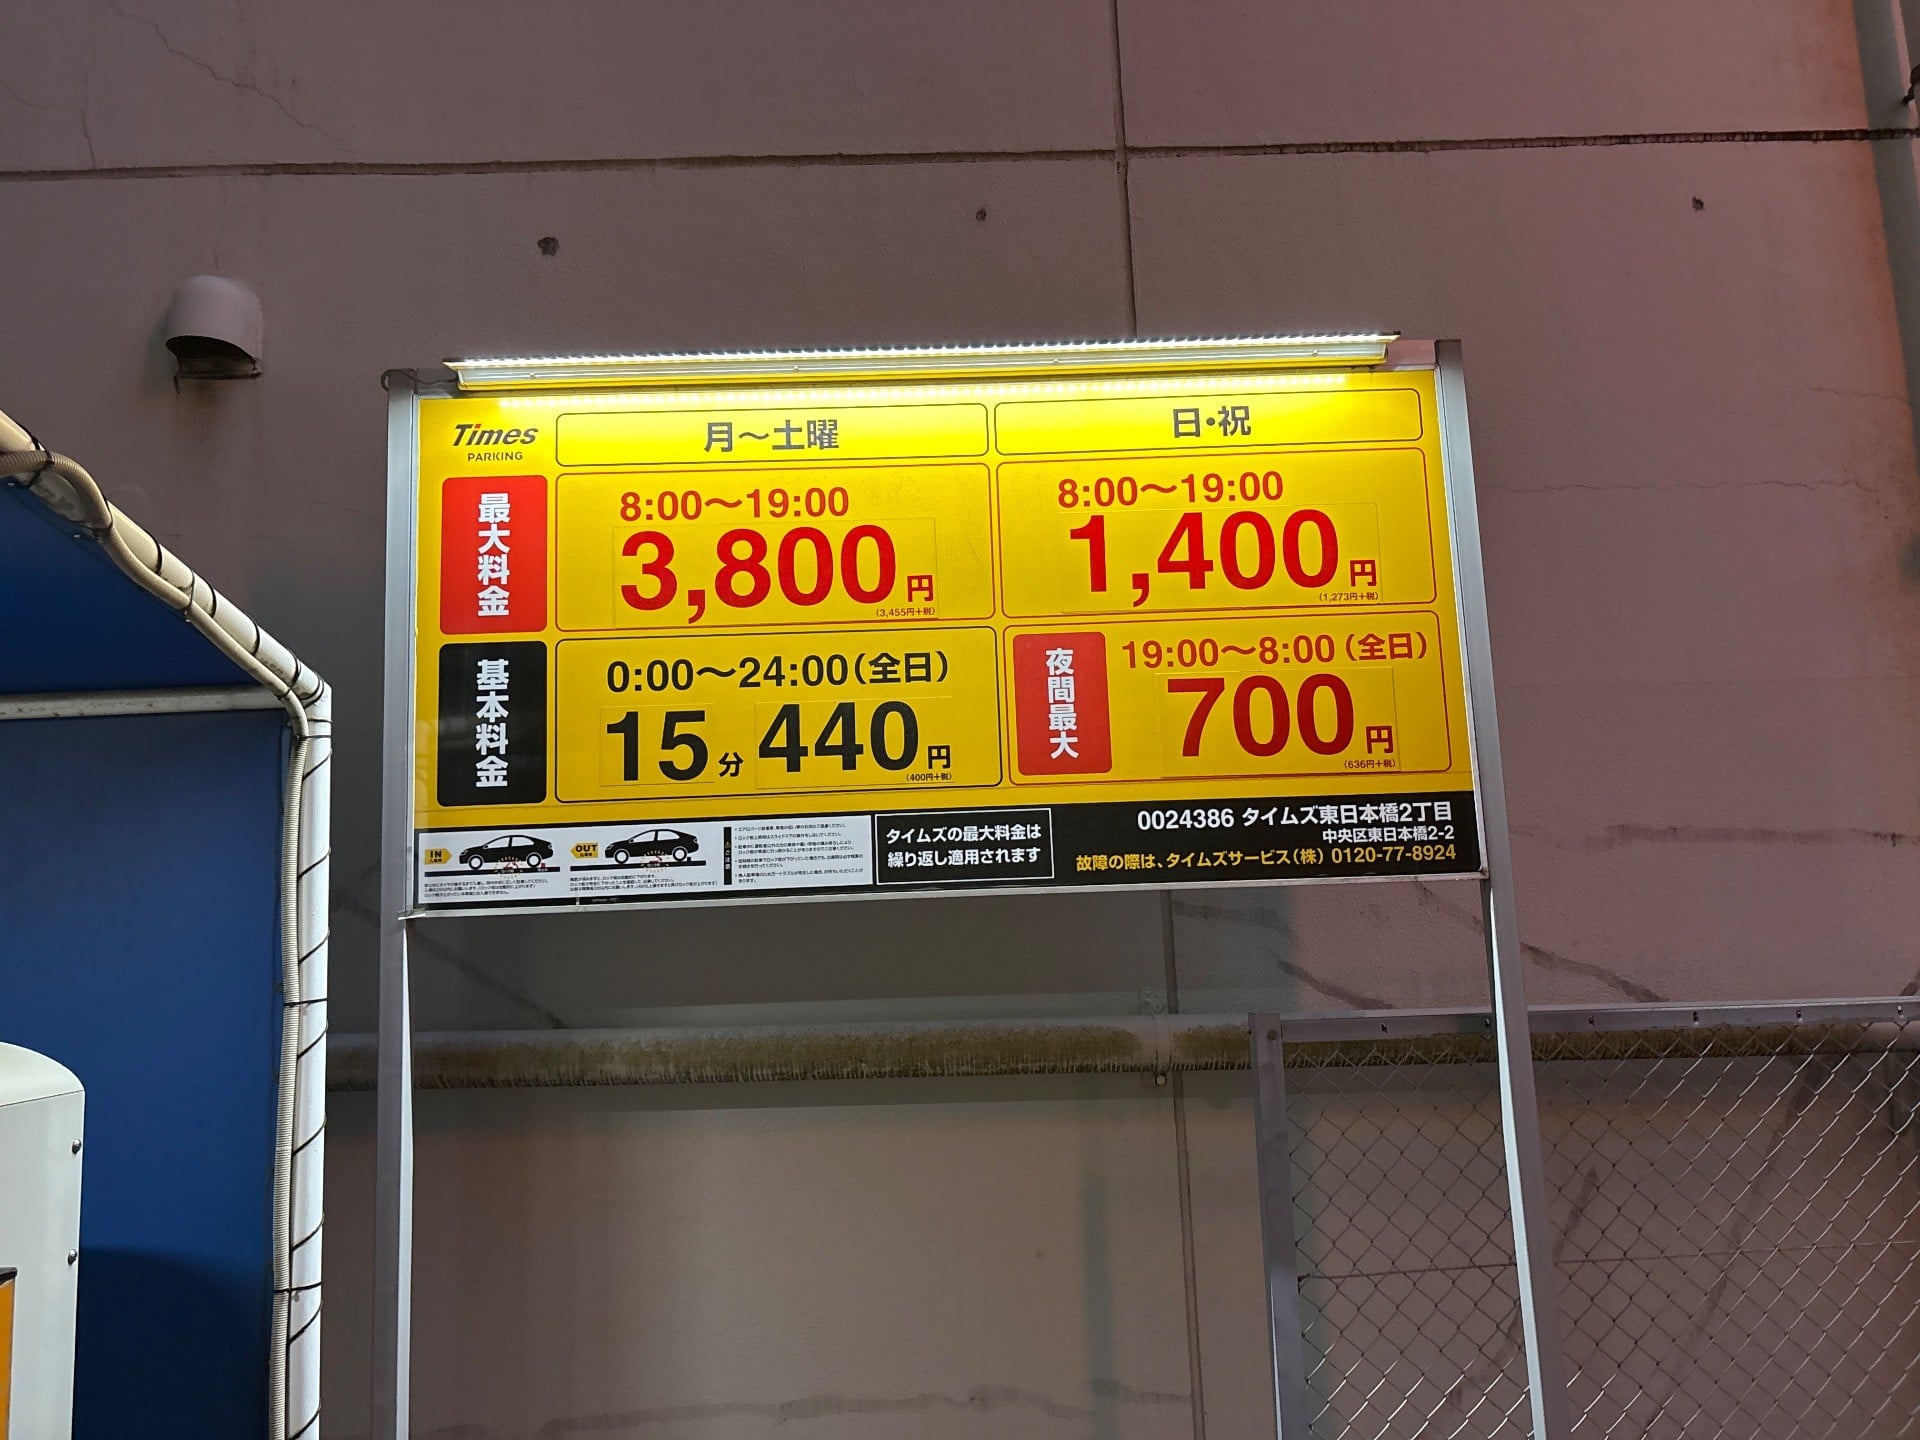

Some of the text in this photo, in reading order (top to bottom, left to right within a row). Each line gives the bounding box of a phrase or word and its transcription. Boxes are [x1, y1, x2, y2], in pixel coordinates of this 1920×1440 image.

[454, 424, 538, 446] Times
[467, 452, 523, 462] PARKING
[478, 493, 511, 617] 最大料金
[1046, 648, 1078, 759] 夜間最大
[476, 659, 509, 787] 基本料金
[1138, 801, 1453, 830] 0024386 タイムズ東日本橋2丁目
[887, 824, 1041, 844] タイムズの最大料金は
[1323, 825, 1454, 843] 中央区東日本橋2-2
[430, 850, 442, 858] IN
[575, 845, 598, 853] OUT
[888, 847, 1040, 867] 繰り返し適用されます
[1332, 844, 1456, 863] 0120-77-8924
